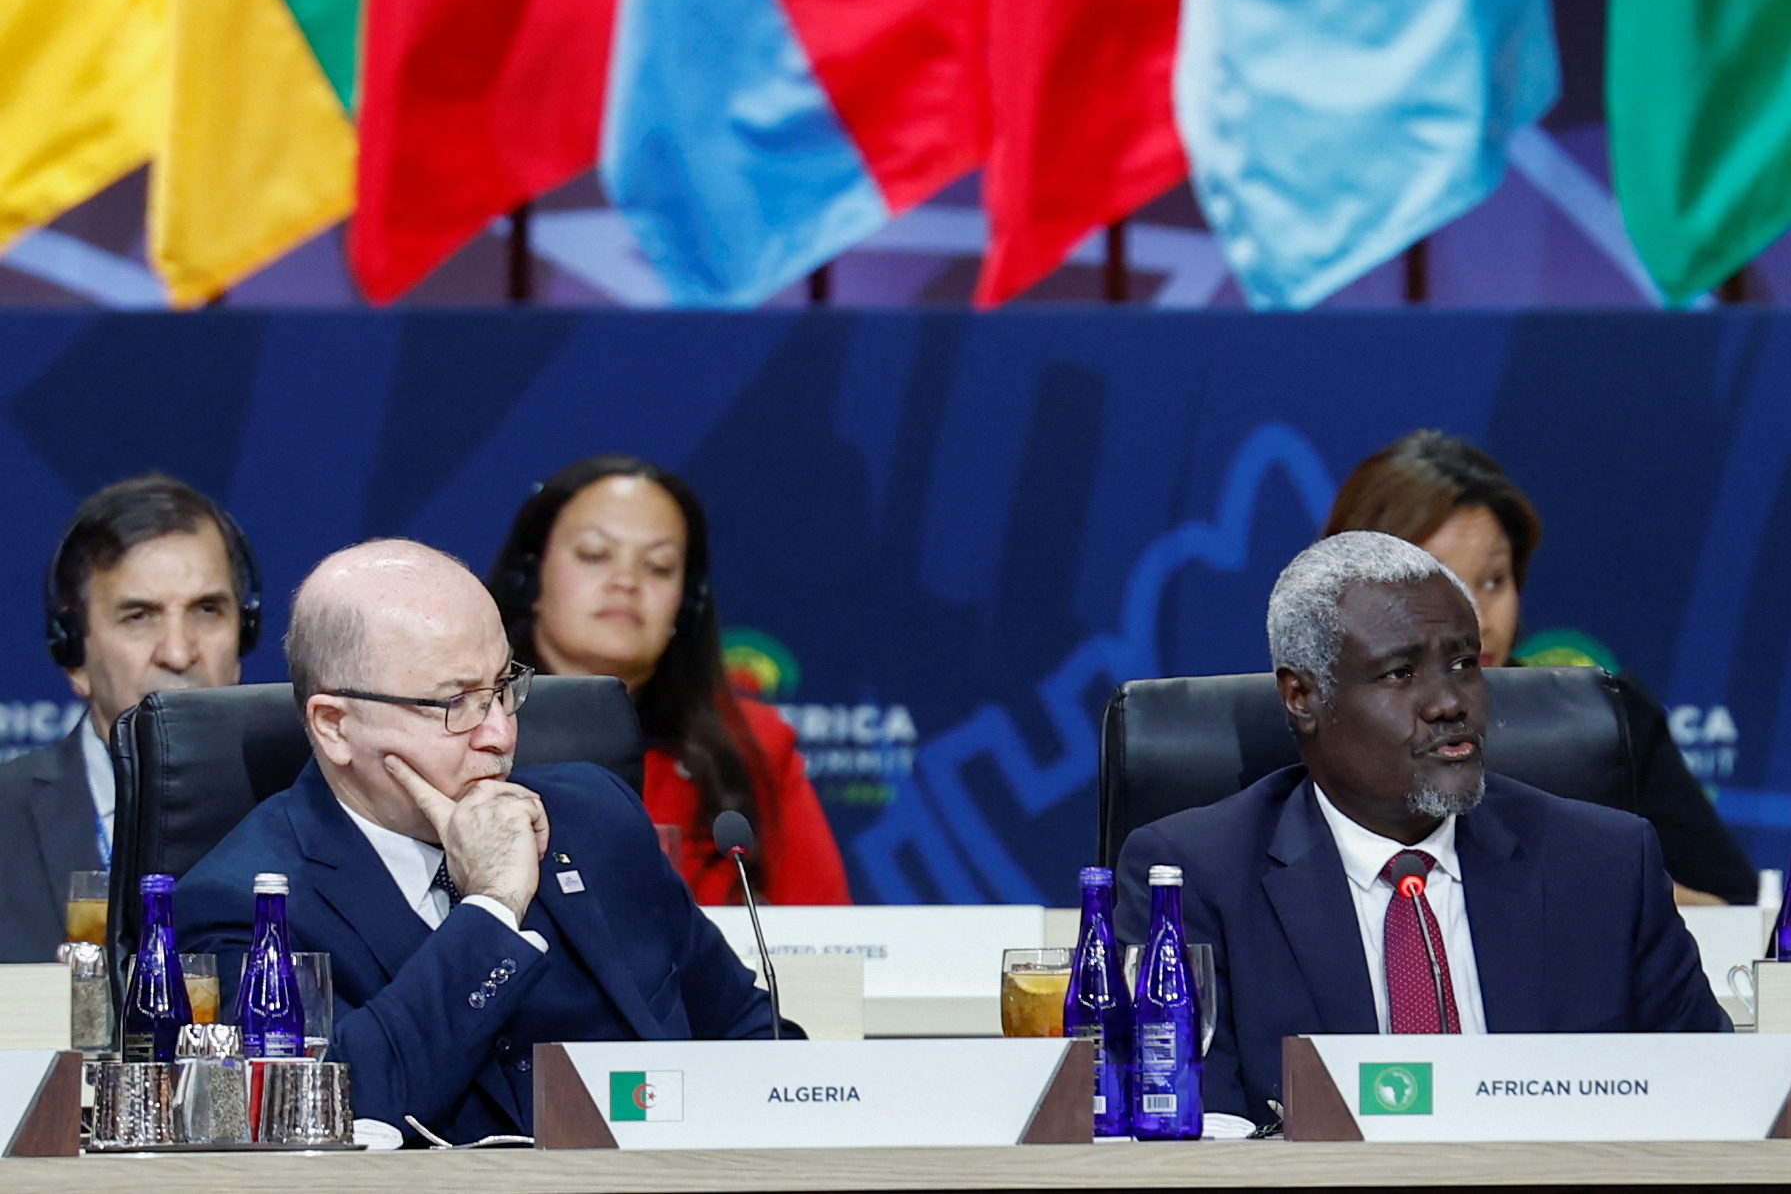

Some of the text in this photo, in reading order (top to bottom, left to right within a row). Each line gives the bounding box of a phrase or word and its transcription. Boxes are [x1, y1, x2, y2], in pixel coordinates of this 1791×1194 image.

[767, 1085, 861, 1103] ALGERIA
[1475, 1079, 1649, 1096] AFRICAN UNION
